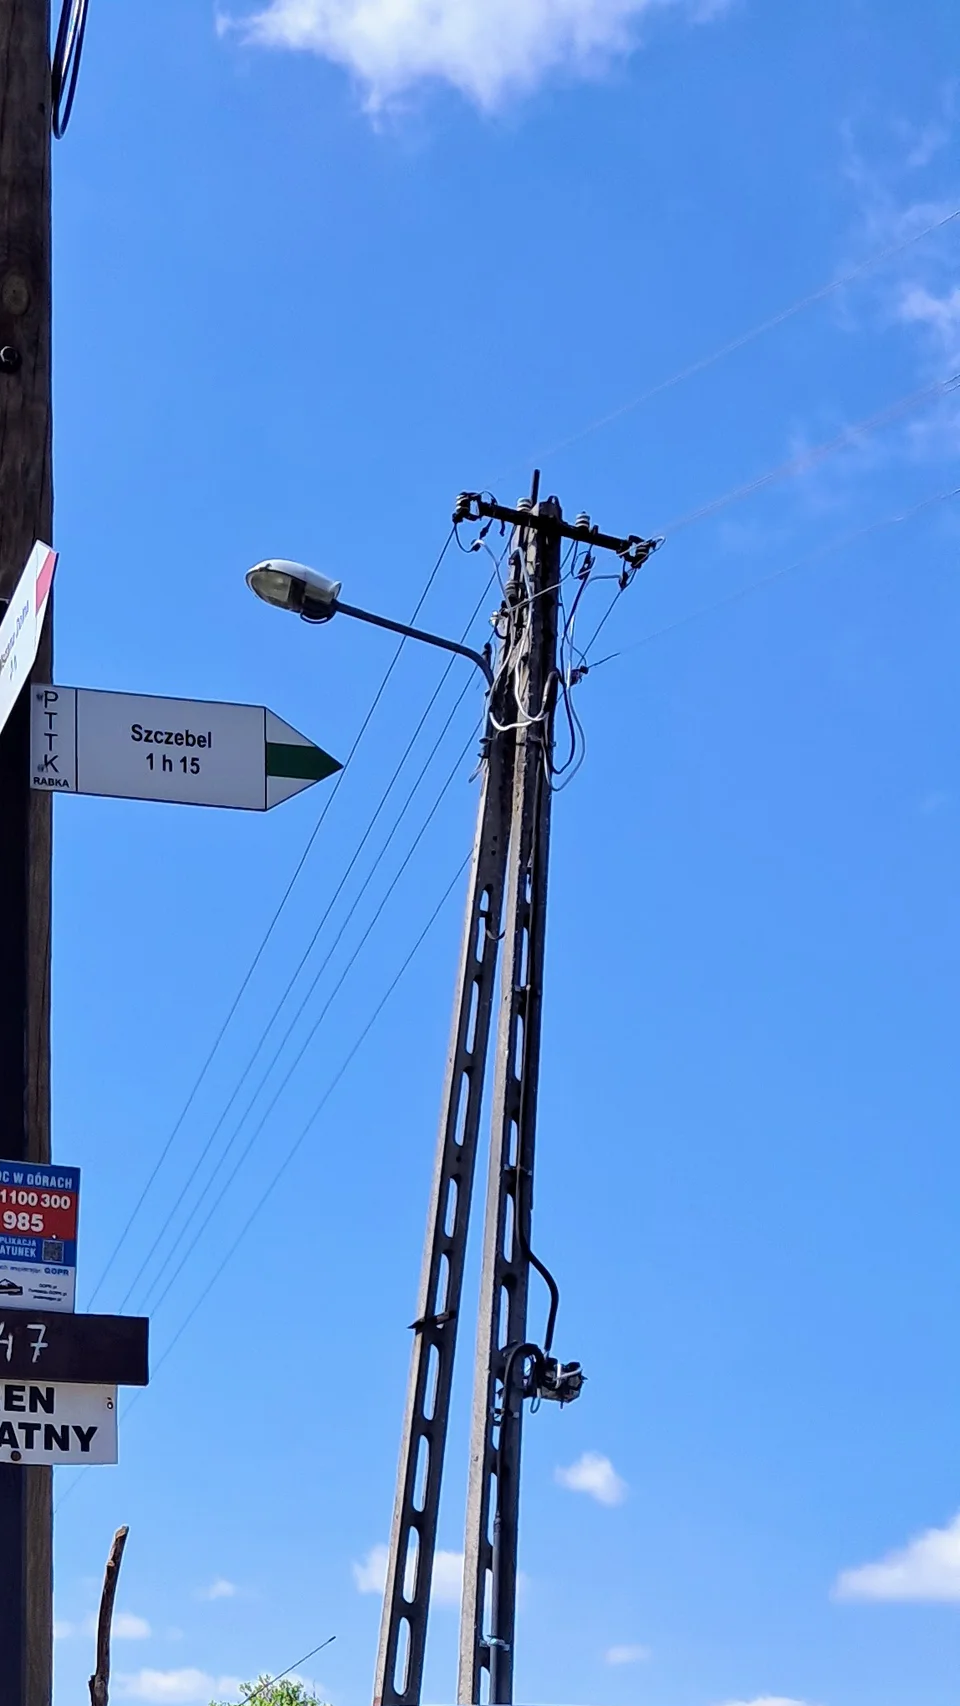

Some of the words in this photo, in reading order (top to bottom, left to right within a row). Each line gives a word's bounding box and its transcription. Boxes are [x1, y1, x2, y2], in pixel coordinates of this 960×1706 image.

[43, 690, 60, 773] PTTK
[130, 723, 212, 749] Szczebel
[146, 752, 155, 771] 1
[162, 753, 174, 773] h
[180, 755, 201, 775] 15
[33, 776, 70, 788] RABKA
[13, 1172, 24, 1184] W
[26, 1172, 73, 1190] GÓRACH
[40, 1194, 71, 1210] 300
[3, 1210, 44, 1233] 985
